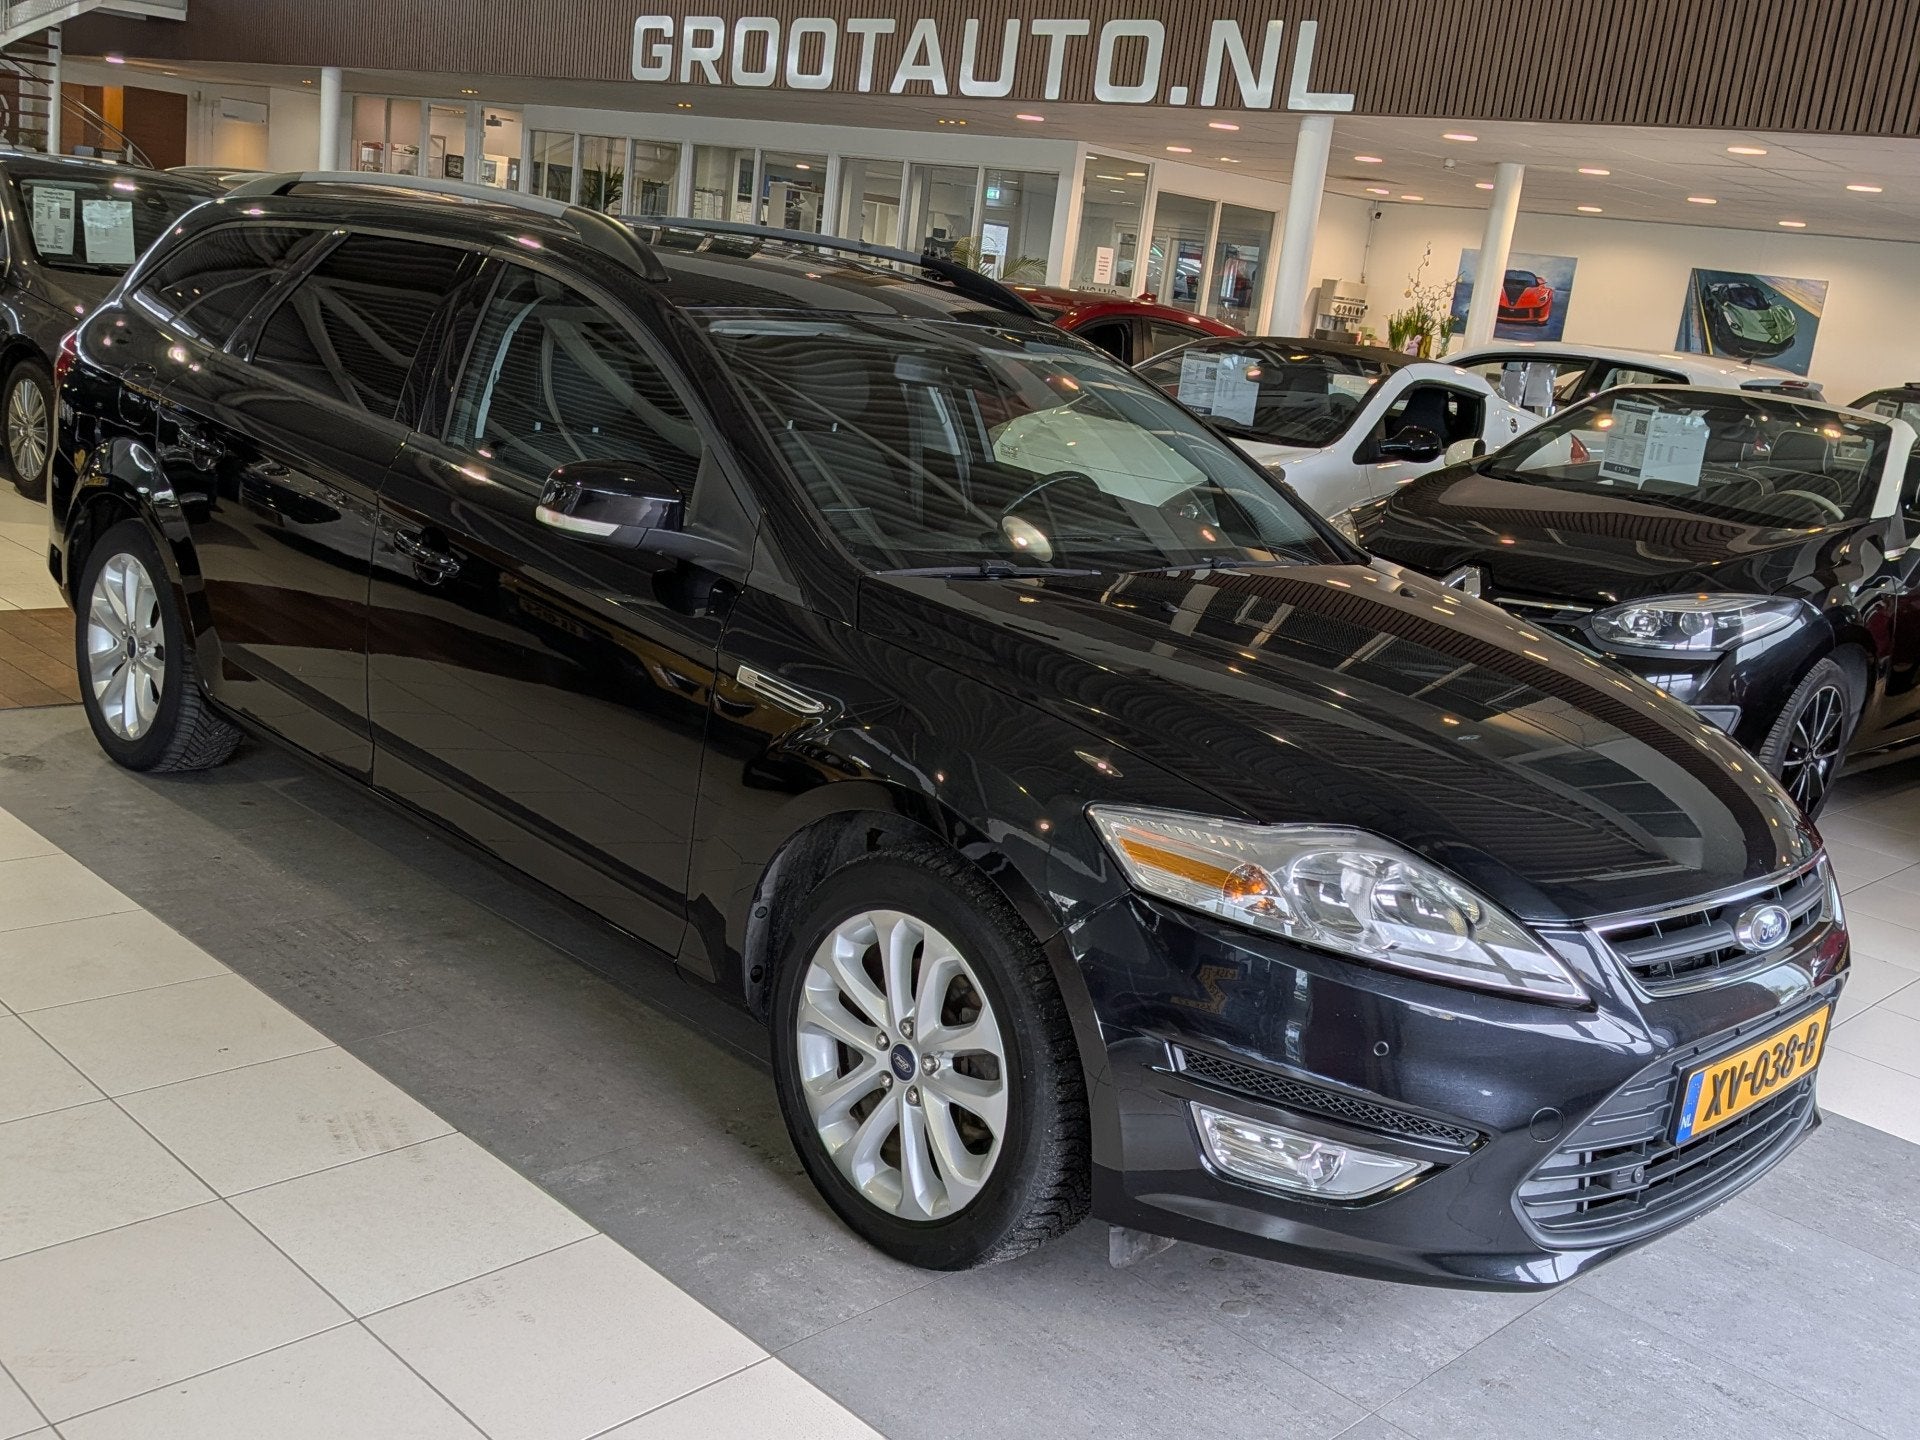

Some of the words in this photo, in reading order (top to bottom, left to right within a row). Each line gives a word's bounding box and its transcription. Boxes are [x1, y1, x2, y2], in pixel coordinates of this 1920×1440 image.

[631, 15, 1355, 111] GROOTAUTO.NL
[1703, 1022, 1820, 1121] XV-038-B
[1680, 1114, 1692, 1130] NL
